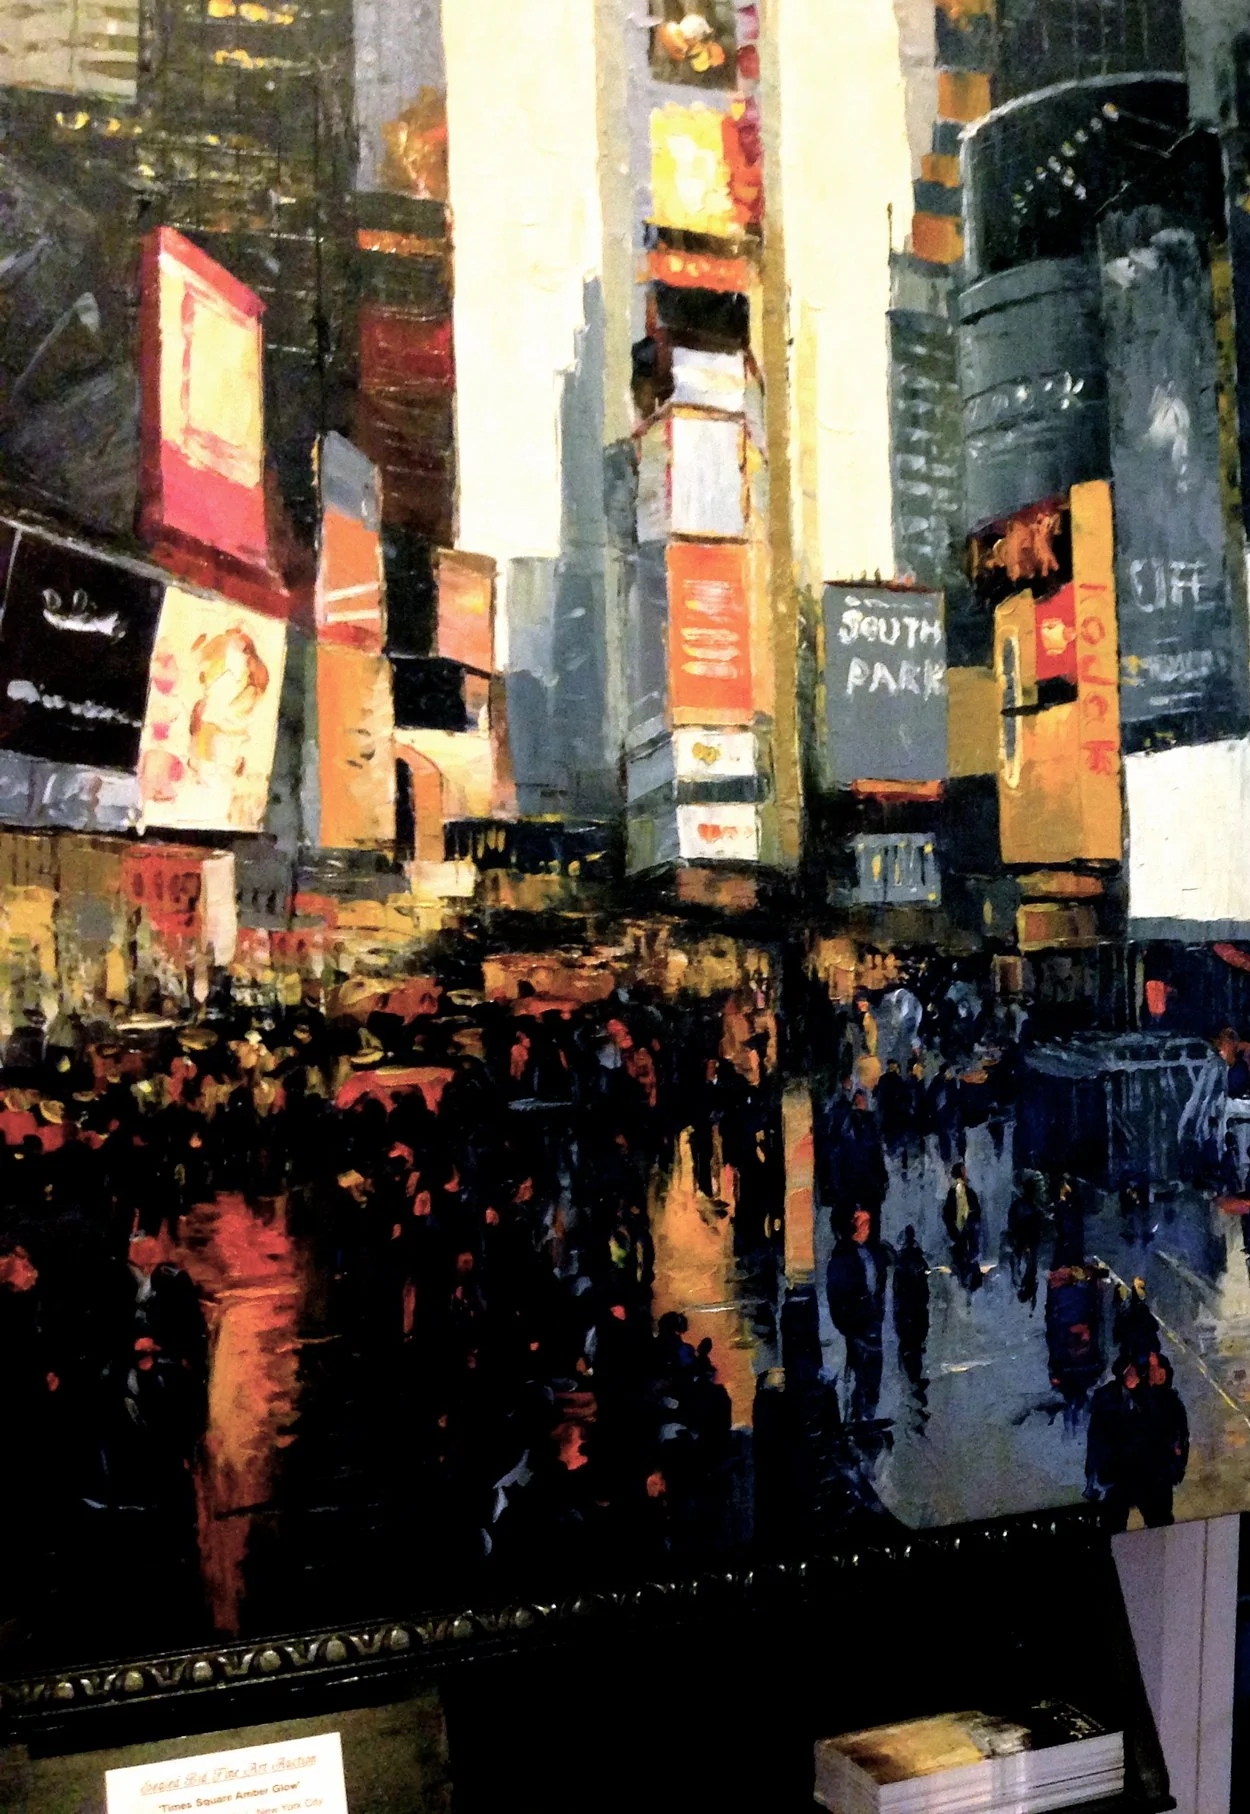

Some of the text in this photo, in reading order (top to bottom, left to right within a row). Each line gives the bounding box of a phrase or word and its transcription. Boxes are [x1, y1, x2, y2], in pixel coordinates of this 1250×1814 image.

[838, 609, 942, 649] SOUTH
[846, 656, 946, 702] PARK
[195, 1794, 233, 1809] Square
[235, 1787, 269, 1801] Amber
